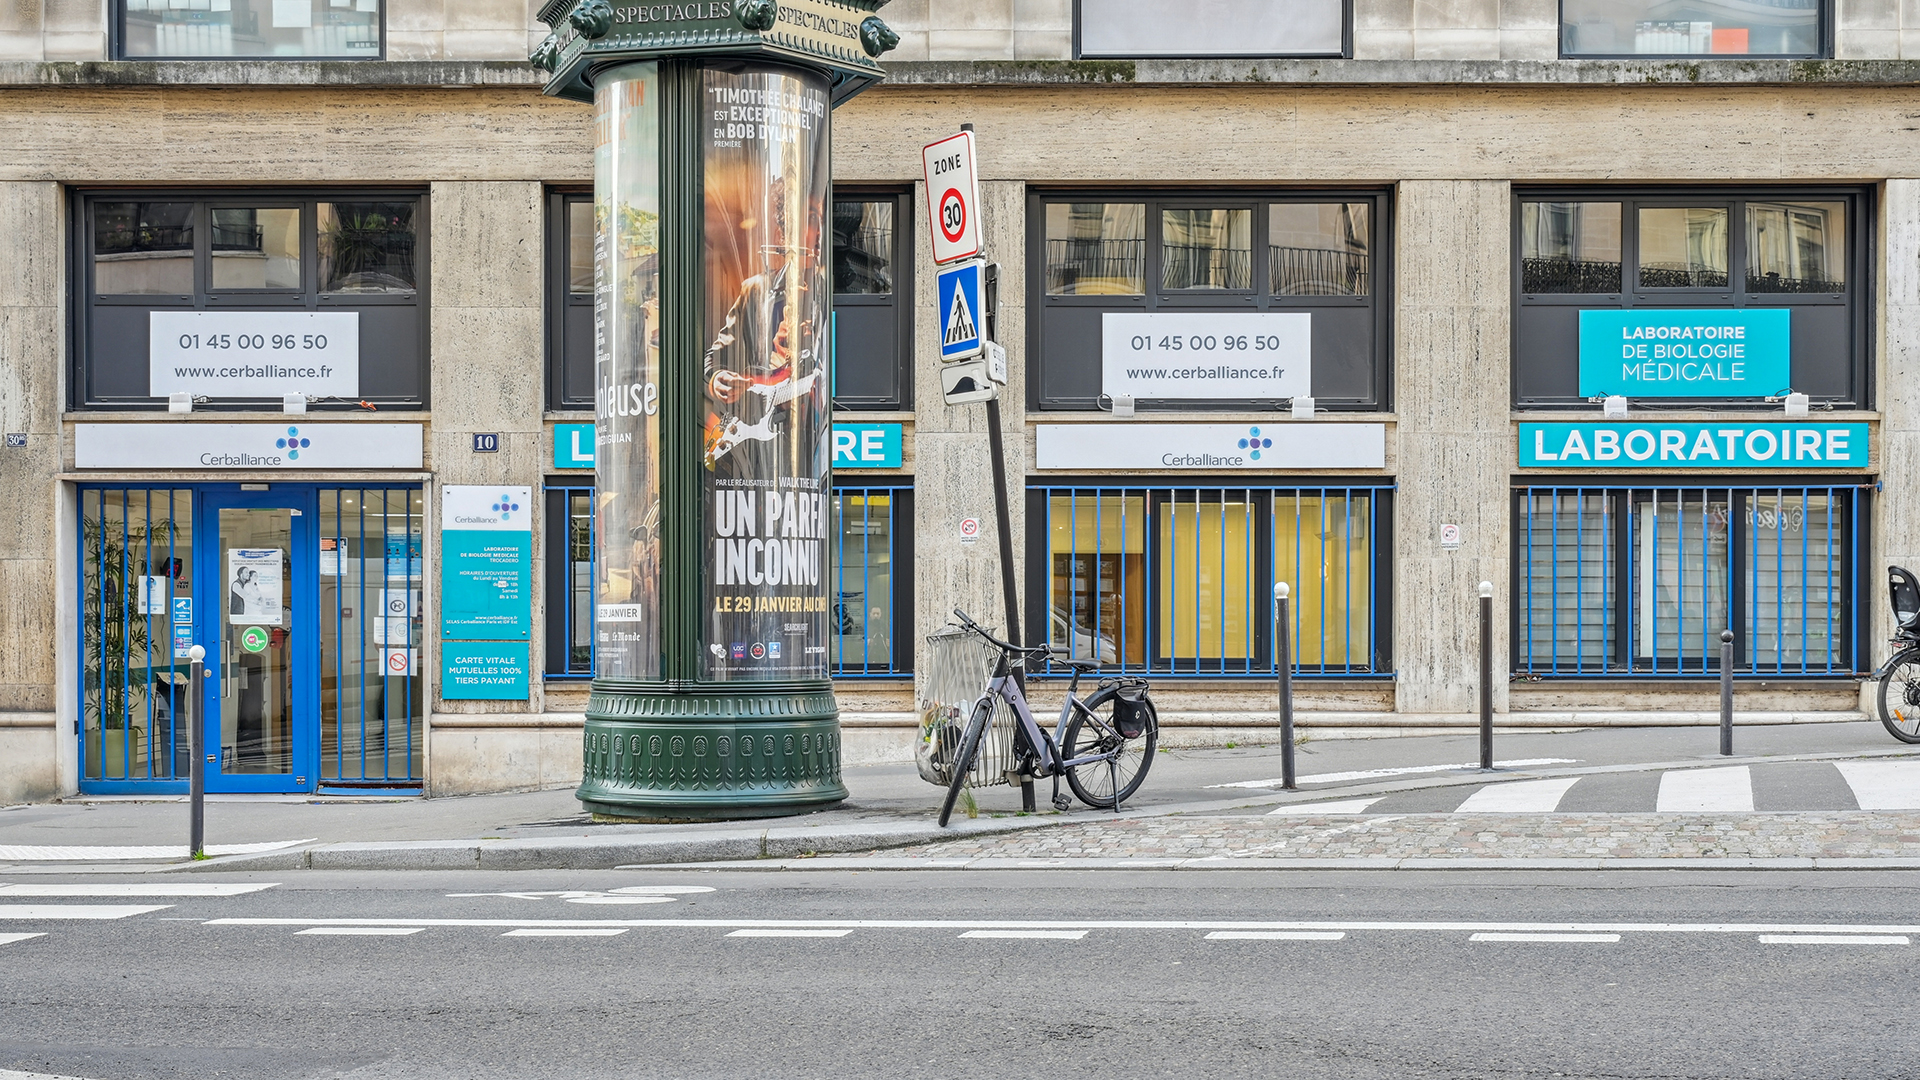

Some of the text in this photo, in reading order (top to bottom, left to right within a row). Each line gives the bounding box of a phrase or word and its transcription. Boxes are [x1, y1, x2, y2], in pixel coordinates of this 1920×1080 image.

[615, 2, 731, 24] SPECTACLES
[778, 6, 858, 40] SPECTACLES
[714, 105, 811, 130] EST EXCEPTIONNEL
[714, 128, 725, 139] EN
[727, 123, 755, 139] BOB
[934, 153, 961, 176] ZONE
[944, 202, 961, 229] 30
[1622, 326, 1745, 340] LABORATOIRE
[180, 334, 328, 350] 01 45 00 96 50
[1131, 335, 1280, 351] 01 45 00 96 50
[1622, 344, 1745, 359] DE BIOLOGIE
[174, 365, 332, 379] www.cerballiance.fr
[1127, 366, 1285, 380] www.cerballiance.fr
[1622, 359, 1745, 381] MÉDICALE
[477, 435, 494, 450] 10
[572, 430, 594, 461] L
[832, 430, 885, 461] RE
[1535, 430, 1850, 461] LABORATOIRE
[200, 452, 282, 467] Cerballiance
[1161, 452, 1243, 467] Cerballiance
[716, 479, 727, 487] PAR
[728, 479, 735, 487] LE
[735, 477, 770, 487] RÉALISATEUR
[778, 477, 799, 488] WALK
[800, 478, 809, 489] THE
[454, 515, 498, 524] Cerballiance
[715, 490, 756, 537] UN
[715, 538, 819, 586] INCONNU
[716, 596, 732, 612] LE
[734, 596, 752, 612] 29
[754, 596, 802, 612] JANVIER
[803, 596, 814, 612] AU
[608, 608, 638, 618] JANVIER
[618, 631, 640, 641] Monde
[500, 667, 522, 675] 100%
